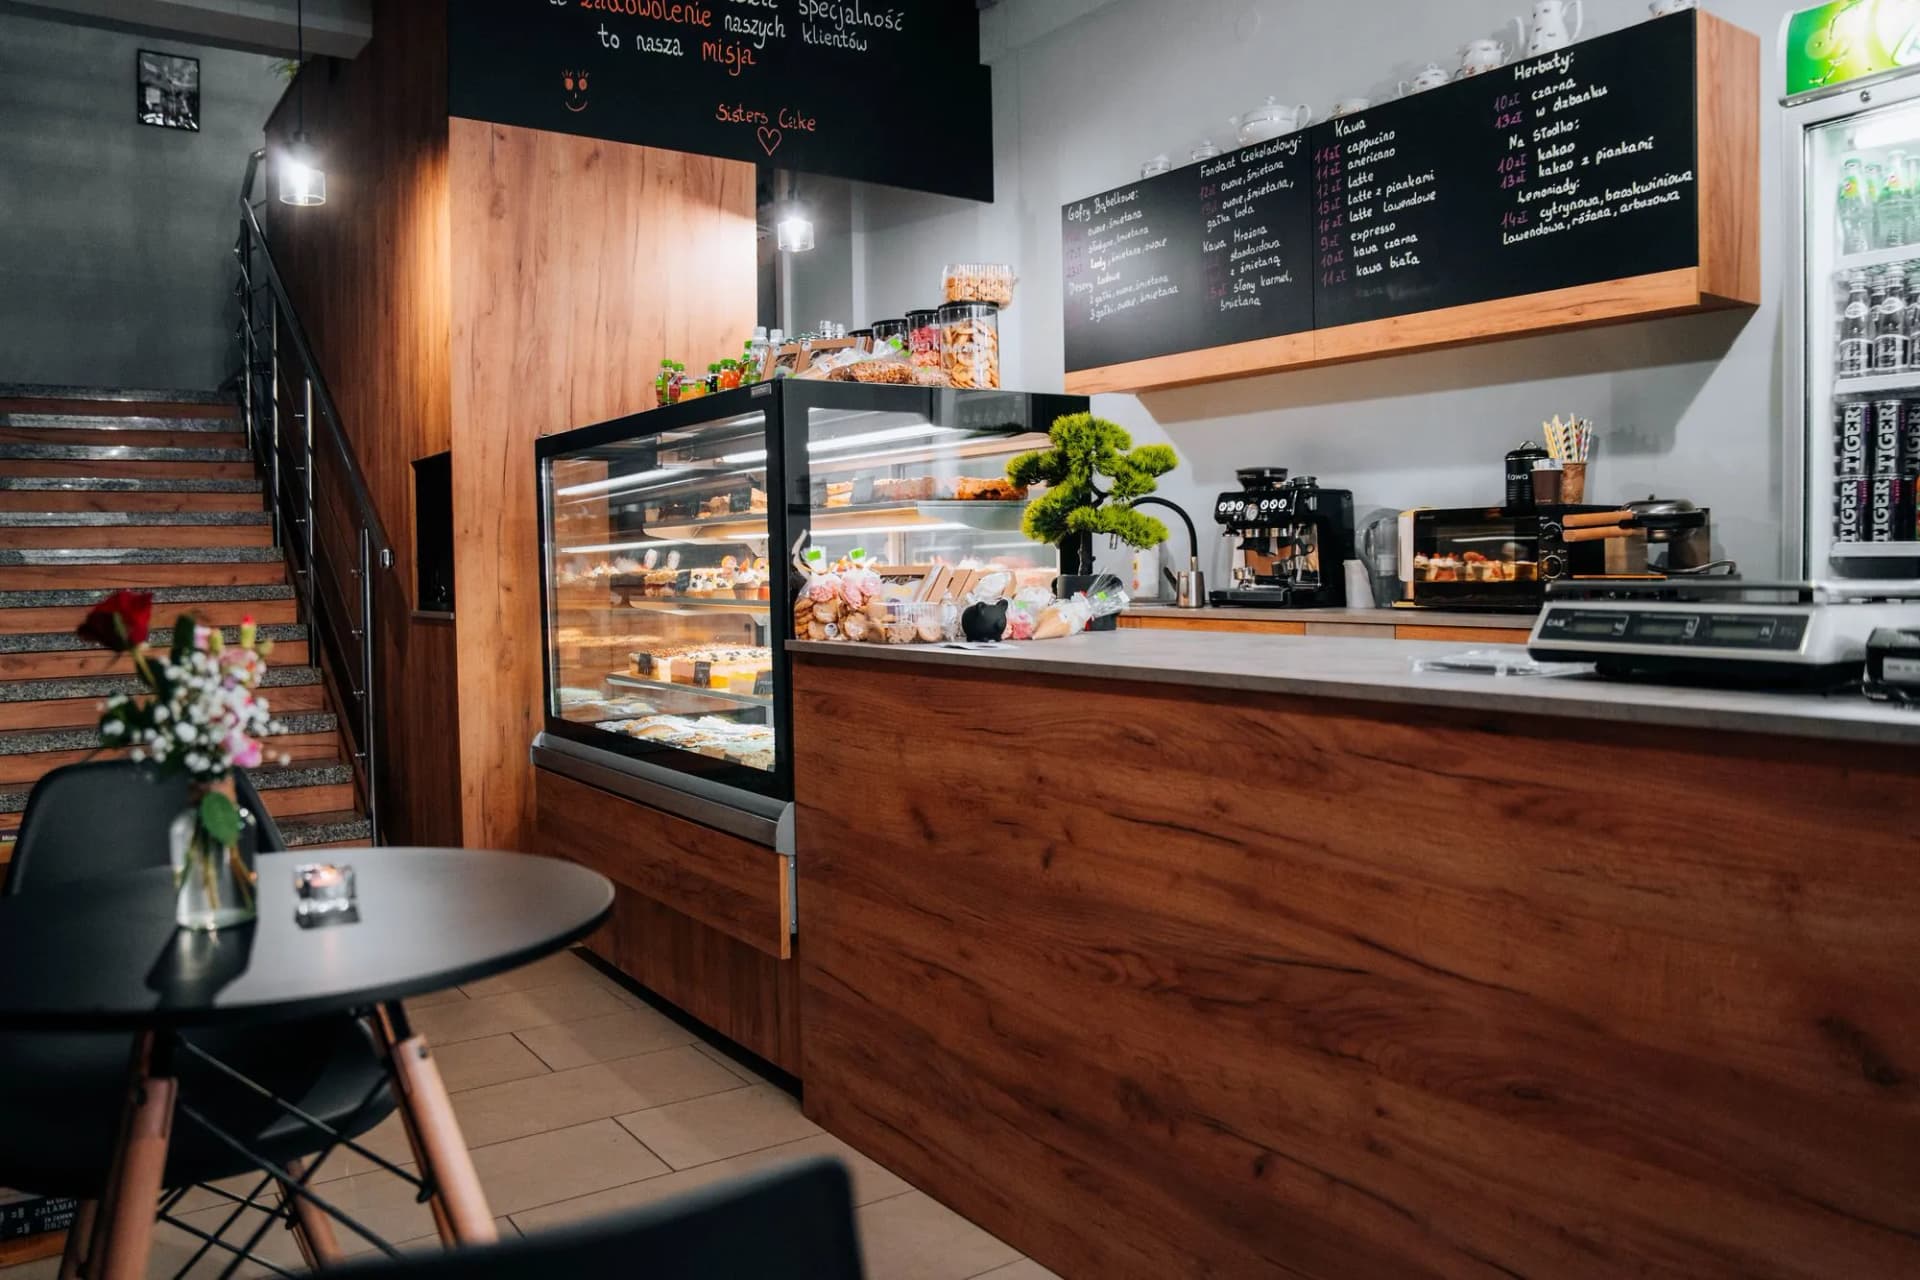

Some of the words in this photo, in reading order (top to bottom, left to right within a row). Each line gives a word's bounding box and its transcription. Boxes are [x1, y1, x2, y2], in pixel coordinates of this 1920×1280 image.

[799, 0, 904, 31] specjalność
[724, 14, 786, 49] naszych
[801, 22, 867, 52] klientów
[597, 23, 620, 48] to
[636, 35, 684, 56] nasza
[702, 38, 756, 76] misja
[1514, 52, 1575, 80] Herbaty:
[1531, 77, 1576, 101] czarna
[1535, 106, 1547, 118] w
[1552, 84, 1608, 112] dzbanku
[715, 103, 769, 124] Sisters
[779, 107, 816, 132] Cake
[1335, 119, 1367, 137] Kawa
[1347, 130, 1396, 155] cappucino
[1509, 134, 1525, 150] Na
[1537, 142, 1576, 162] kakao
[1200, 156, 1237, 179] Fondant
[1347, 147, 1396, 170] americano
[1538, 159, 1575, 178] kakao
[1595, 136, 1655, 165] piankami
[1386, 169, 1436, 198] piankami
[1067, 203, 1091, 222] Gofry
[1350, 222, 1396, 243] expresso
[1353, 244, 1379, 258] kawa
[1384, 233, 1419, 250] czarna
[1203, 239, 1227, 253] Kawa
[1356, 262, 1384, 277] kawa
[1843, 406, 1861, 472] TIGER
[1877, 405, 1897, 472] TIGER
[1840, 480, 1857, 542] TIGER
[1873, 480, 1890, 542] TIGER
